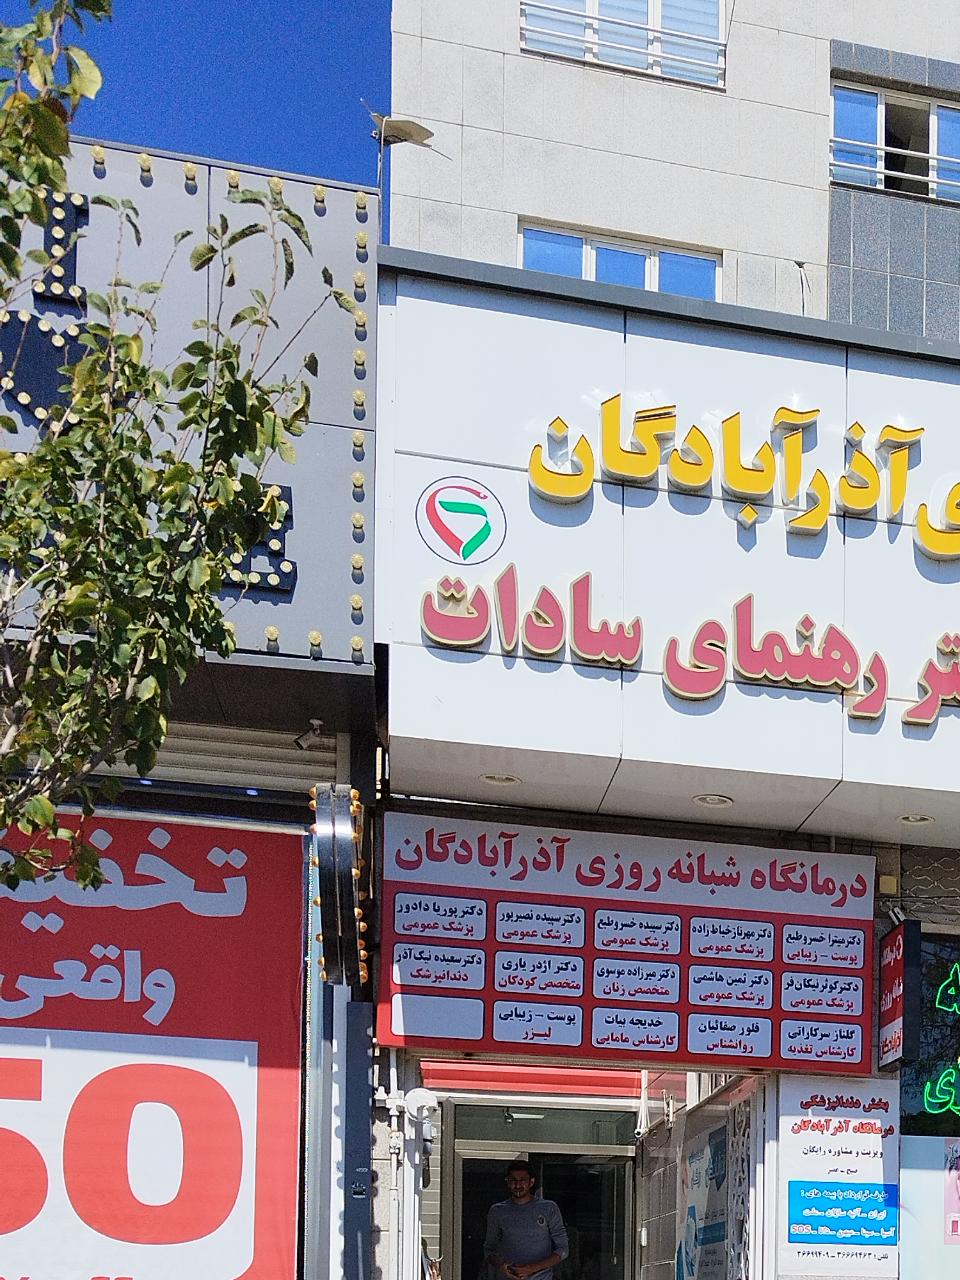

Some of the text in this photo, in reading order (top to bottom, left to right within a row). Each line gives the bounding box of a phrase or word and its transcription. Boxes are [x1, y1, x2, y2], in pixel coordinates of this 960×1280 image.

[528, 393, 926, 537] آذرآبادگان
[420, 562, 643, 669] سادات
[663, 593, 888, 721] رهنمای
[575, 853, 662, 892] روزی
[667, 851, 742, 896] شبانه
[0, 827, 248, 934] تخفی
[750, 858, 868, 908] درمانگاه
[397, 901, 483, 917] دکتر پوریا دادور
[535, 912, 563, 924] سپیده
[561, 913, 581, 926] دکتر
[402, 921, 473, 936] پزشک عمومی
[639, 920, 663, 932] سپیده
[661, 921, 679, 934] دکتر
[730, 927, 757, 939] مهرناز
[754, 927, 772, 940] دکتر
[502, 929, 571, 944] پزشک عمومی
[601, 935, 669, 950] پزشک عمومی
[827, 934, 846, 948] میترا
[842, 934, 861, 947] دکتر
[433, 951, 465, 965] سعیده
[698, 943, 764, 958] پزشک عمومی
[787, 948, 857, 965] پوست زیبایی
[461, 954, 482, 970] دکتر
[502, 958, 577, 975] دکتر اژدر یاری
[410, 967, 469, 983] دندانپزشک
[596, 966, 676, 980] دکتر میرزاده موسوی
[693, 971, 769, 987] دکتر ثمین هاشمی
[498, 975, 581, 991] متخصص کودکان
[603, 981, 670, 997] متخصص زنان
[818, 978, 842, 993] کوثر
[837, 981, 859, 994] دکتر
[699, 990, 764, 1006] پزشک عمومی
[790, 997, 854, 1011] پزشک عمومی
[499, 1006, 576, 1025] پوست زیبایی
[604, 1014, 663, 1030] خدیجه بیات
[740, 1023, 759, 1036] فلور
[830, 1027, 855, 1041] گلناز
[595, 1031, 676, 1046] کارشناس مامایی
[706, 1038, 753, 1054] روانشناس
[788, 1043, 856, 1058] کارشناس تغذیه
[800, 1094, 889, 1113] بخش دندانپزشکی
[853, 1122, 894, 1138] درمانگاه
[802, 1145, 826, 1155] رایگان
[828, 1146, 852, 1156] مشاوره
[861, 1149, 883, 1158] ویزیت
[790, 1224, 812, 1234] SOS
